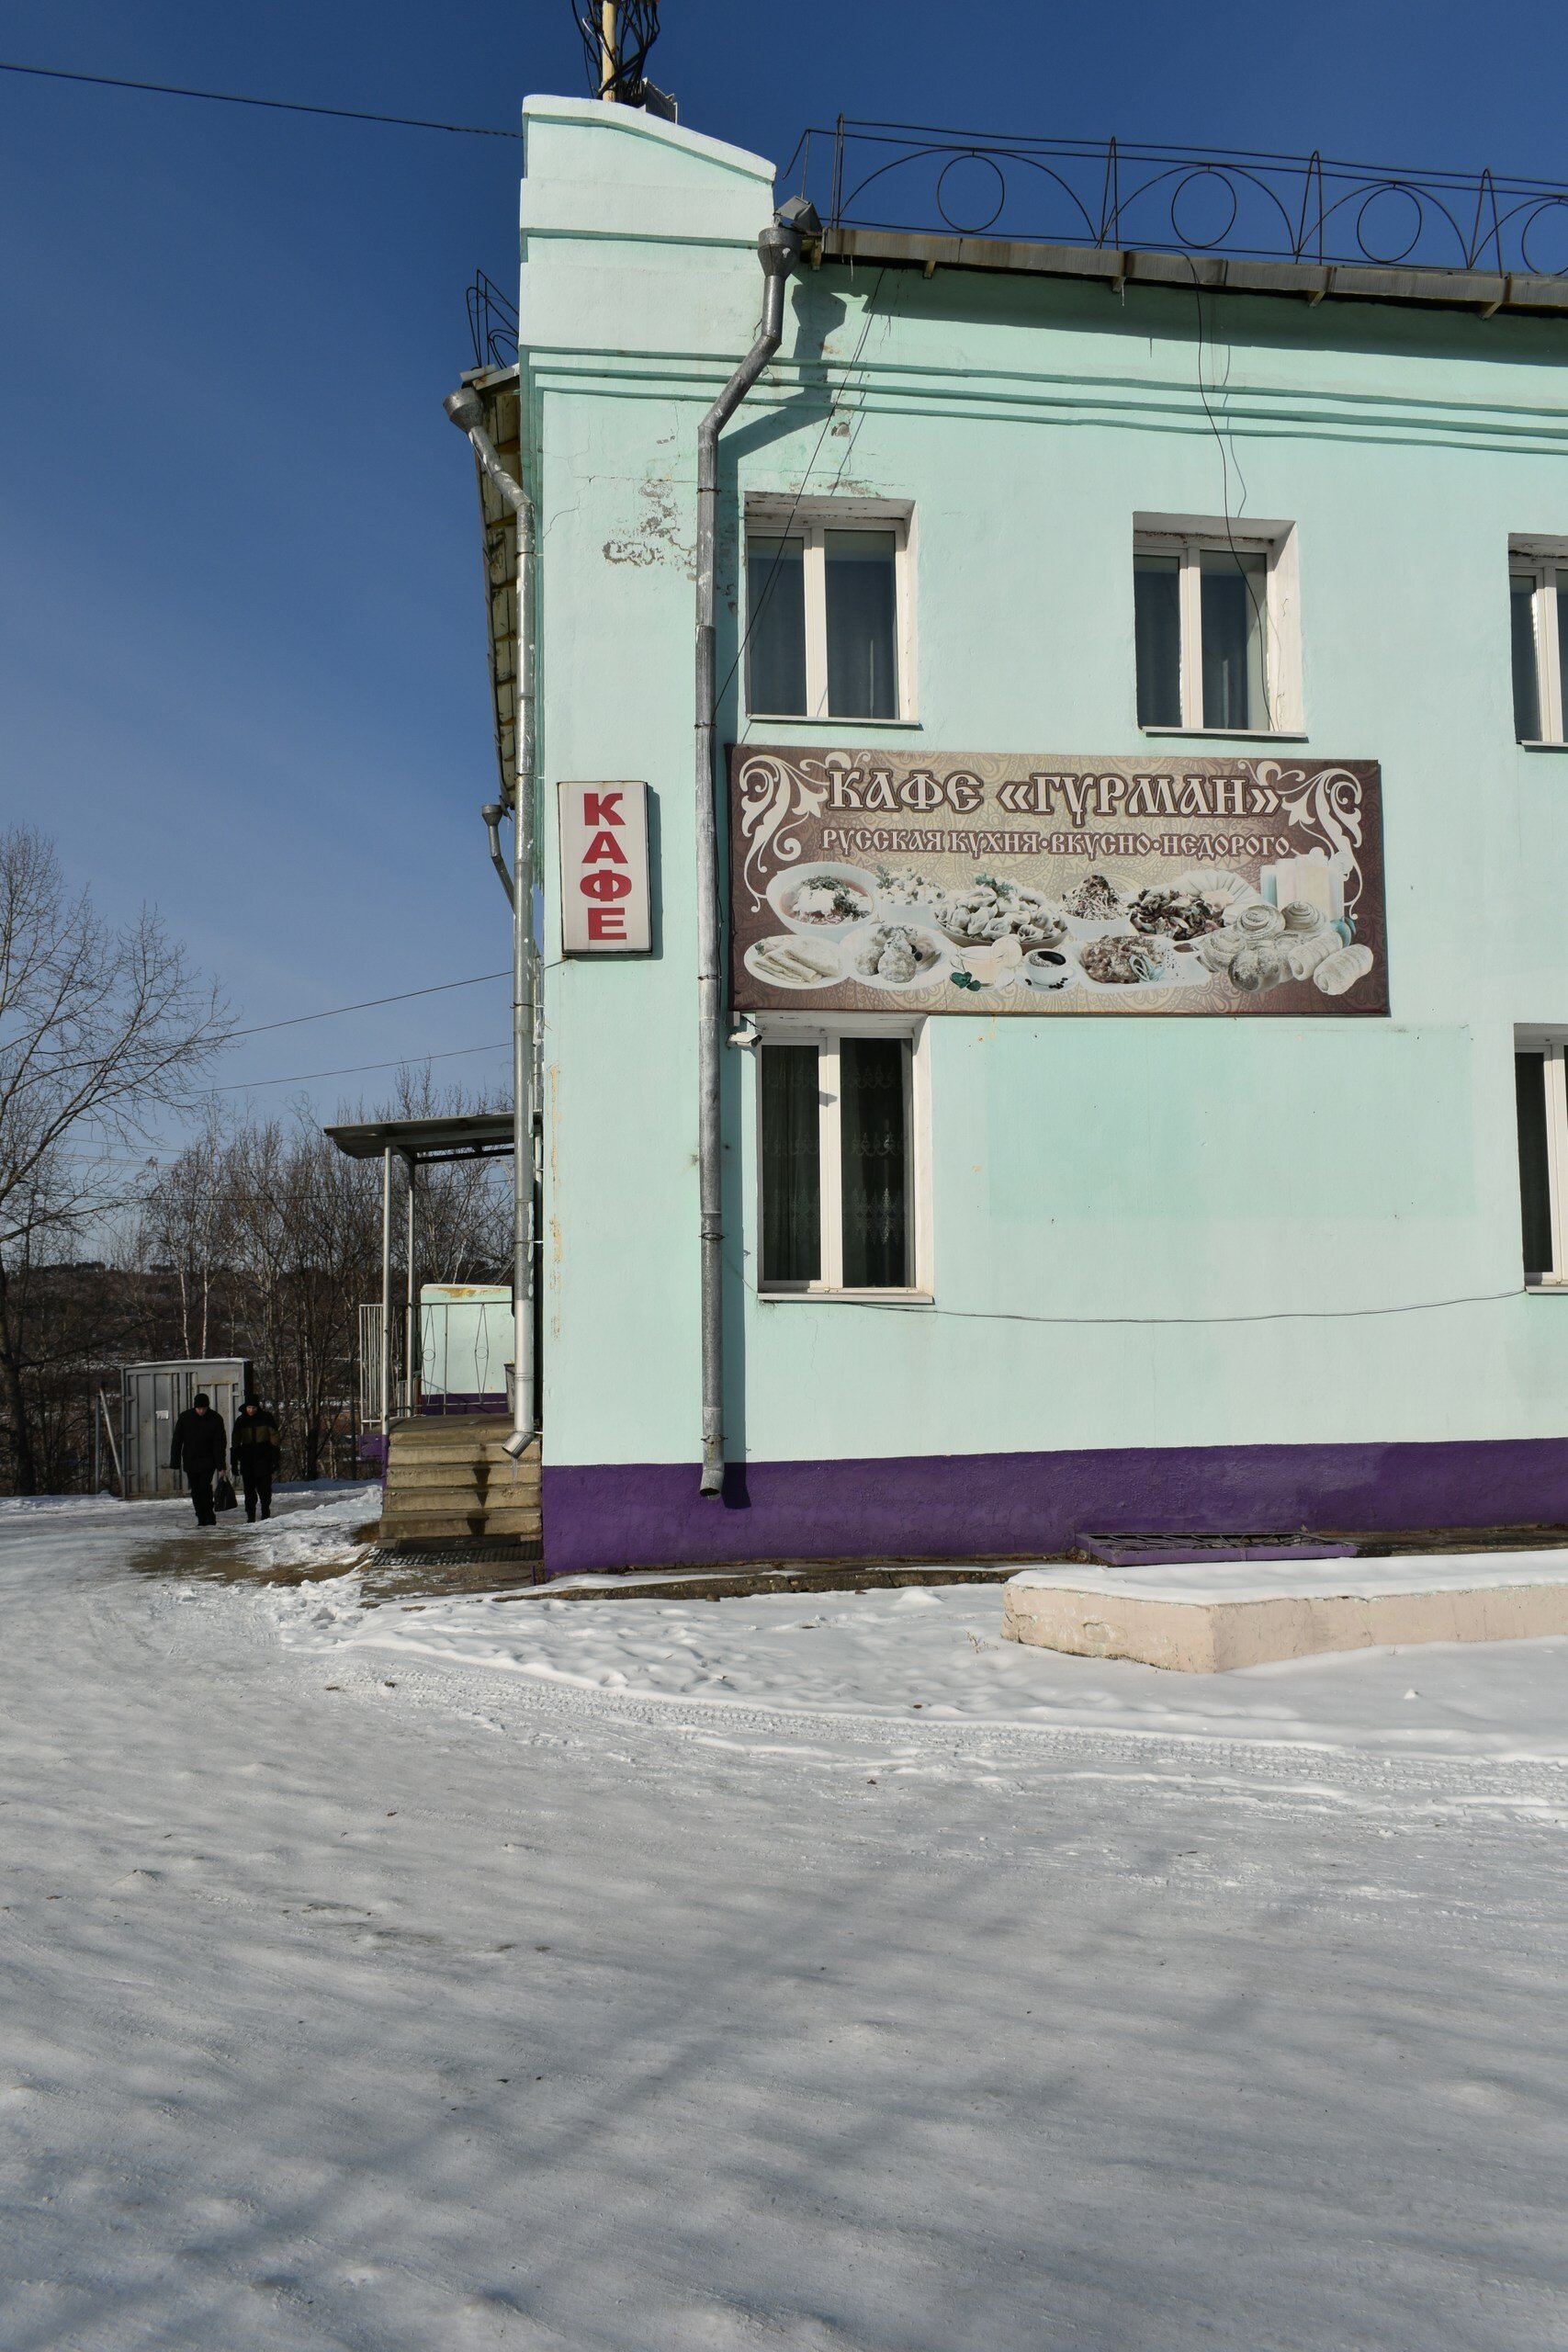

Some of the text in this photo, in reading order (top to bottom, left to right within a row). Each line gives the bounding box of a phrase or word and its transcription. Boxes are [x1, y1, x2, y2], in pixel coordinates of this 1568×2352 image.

[828, 770, 1282, 826] КАФЕ «ГУРМАН»
[580, 793, 632, 941] КАФЕ
[821, 829, 945, 855] РУССКАЯ
